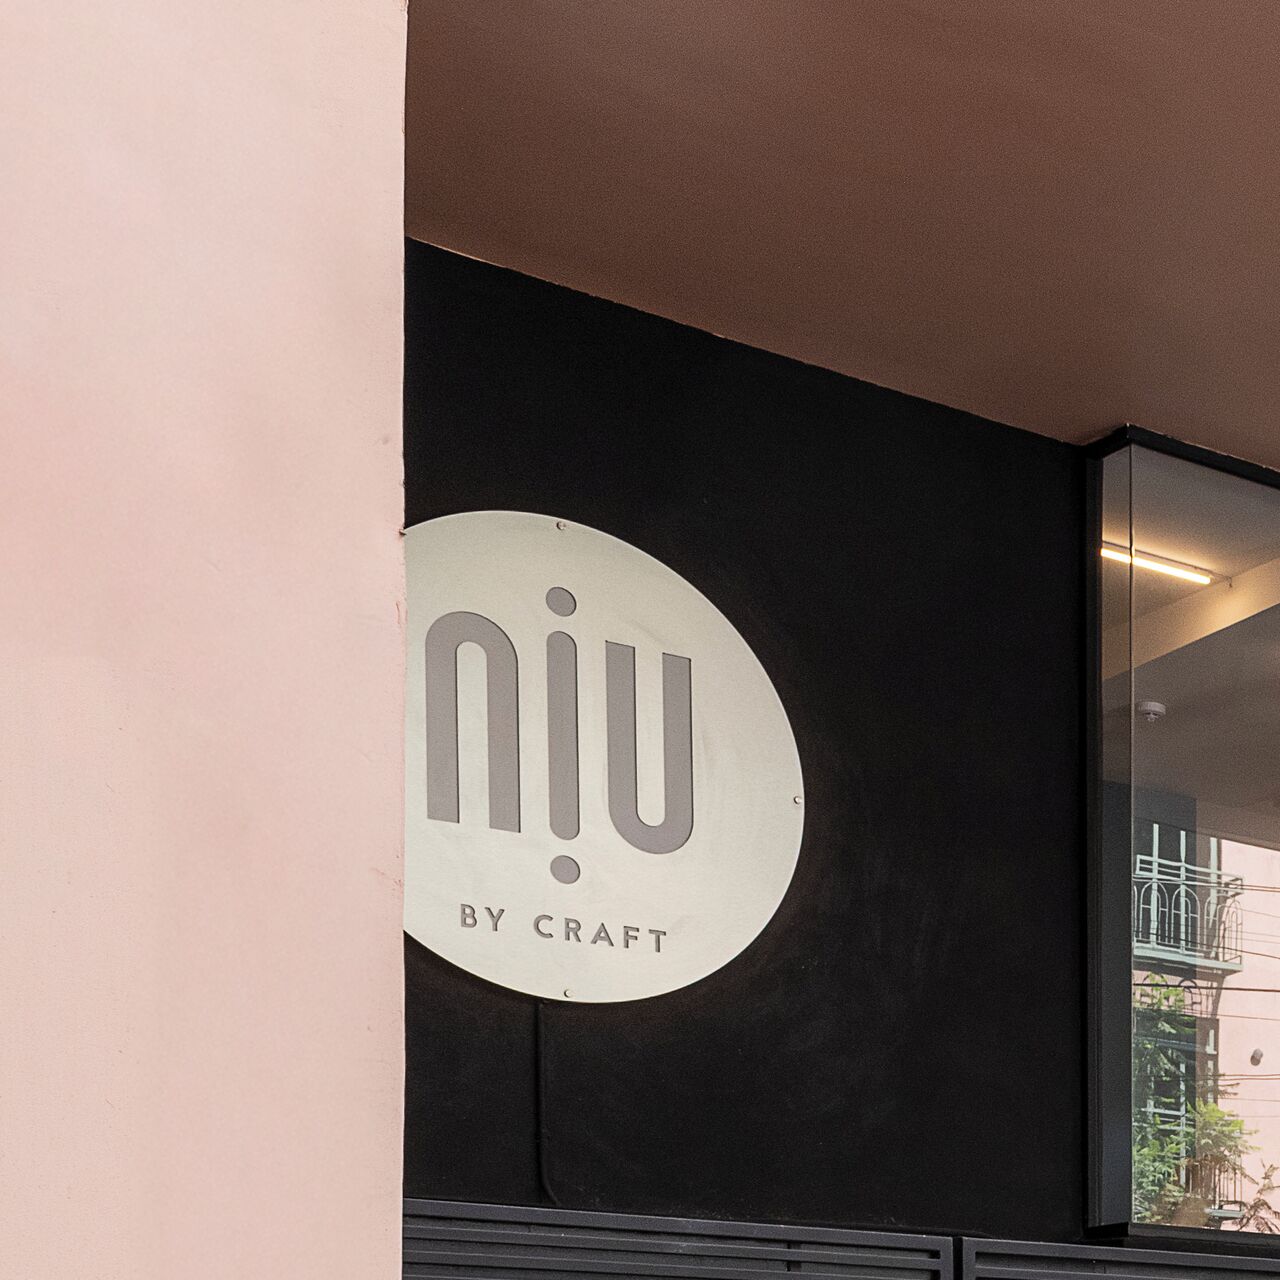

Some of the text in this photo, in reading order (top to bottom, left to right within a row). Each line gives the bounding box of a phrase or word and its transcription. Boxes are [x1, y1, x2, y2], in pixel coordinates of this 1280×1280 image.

[425, 587, 694, 884] niu
[460, 904, 667, 953] BY CRAFT
